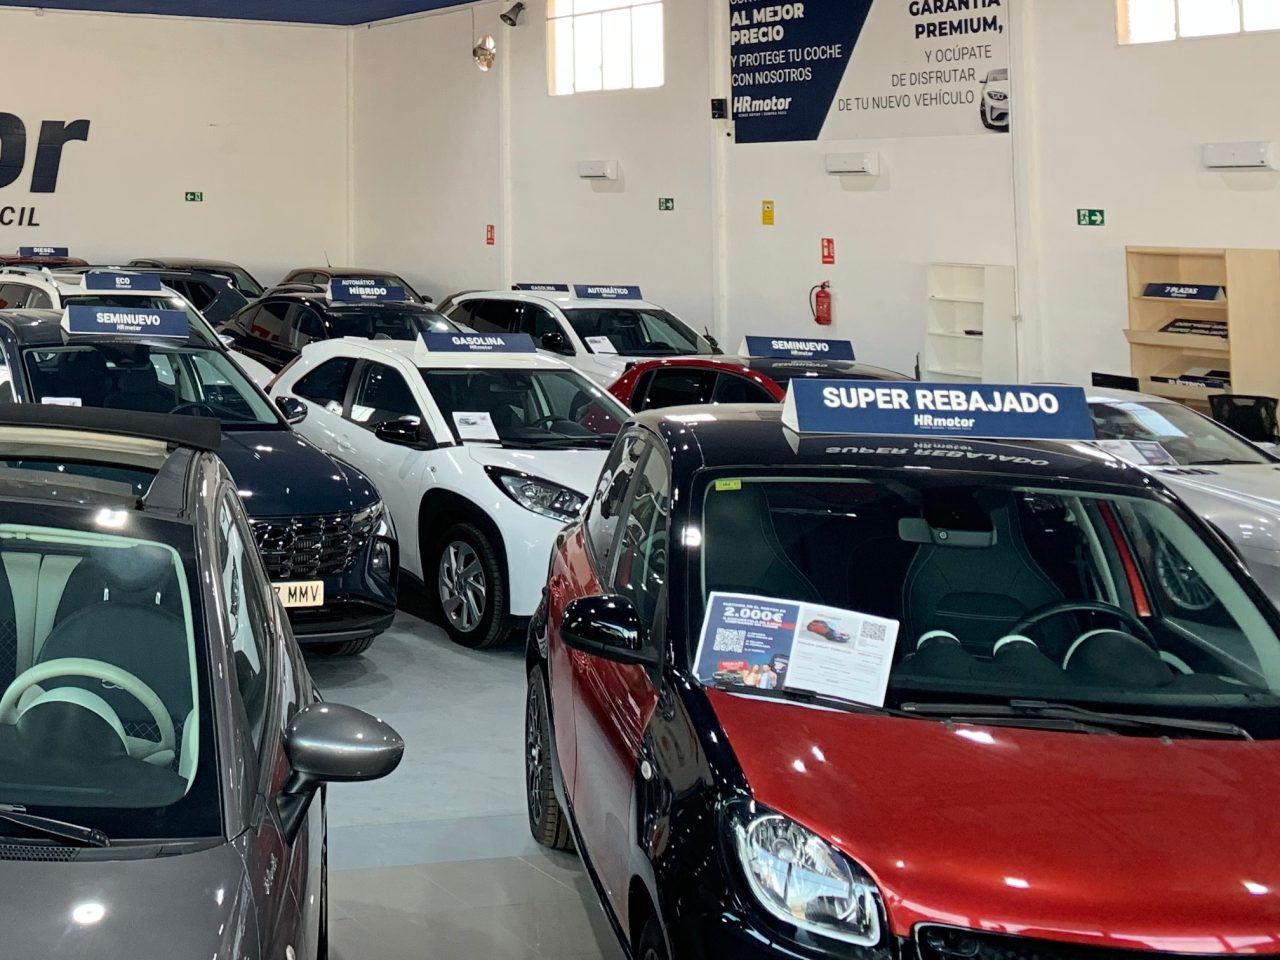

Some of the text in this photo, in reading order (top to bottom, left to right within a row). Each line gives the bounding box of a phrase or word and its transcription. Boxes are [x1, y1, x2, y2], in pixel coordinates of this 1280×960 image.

[731, 3, 805, 27] AL MEJOR
[730, 25, 785, 46] PRECIO
[914, 15, 1003, 40] PREMIUM,
[730, 44, 842, 68] Y PROTEGE TU COCHE
[924, 44, 992, 63] Y OCÚPATE
[731, 67, 812, 87] CON NOSOTROS
[891, 68, 976, 87] DE DISFRUTAR
[733, 95, 792, 113] HRmotor
[838, 88, 975, 112] DE TU NUEVO VEHÍCULO
[115, 277, 131, 285] ECO
[587, 286, 629, 294] AUTOMÁTICO
[348, 286, 387, 295] HÍBRIDO
[96, 312, 161, 326] SEMINUEVO
[451, 336, 506, 346] GASOLINA
[771, 340, 830, 352] SEMINUEVO
[823, 386, 1059, 414] SUPER REBAJADO
[914, 413, 976, 427] HRmotor
[288, 585, 319, 603] MMV
[723, 606, 784, 623] 2.000€
